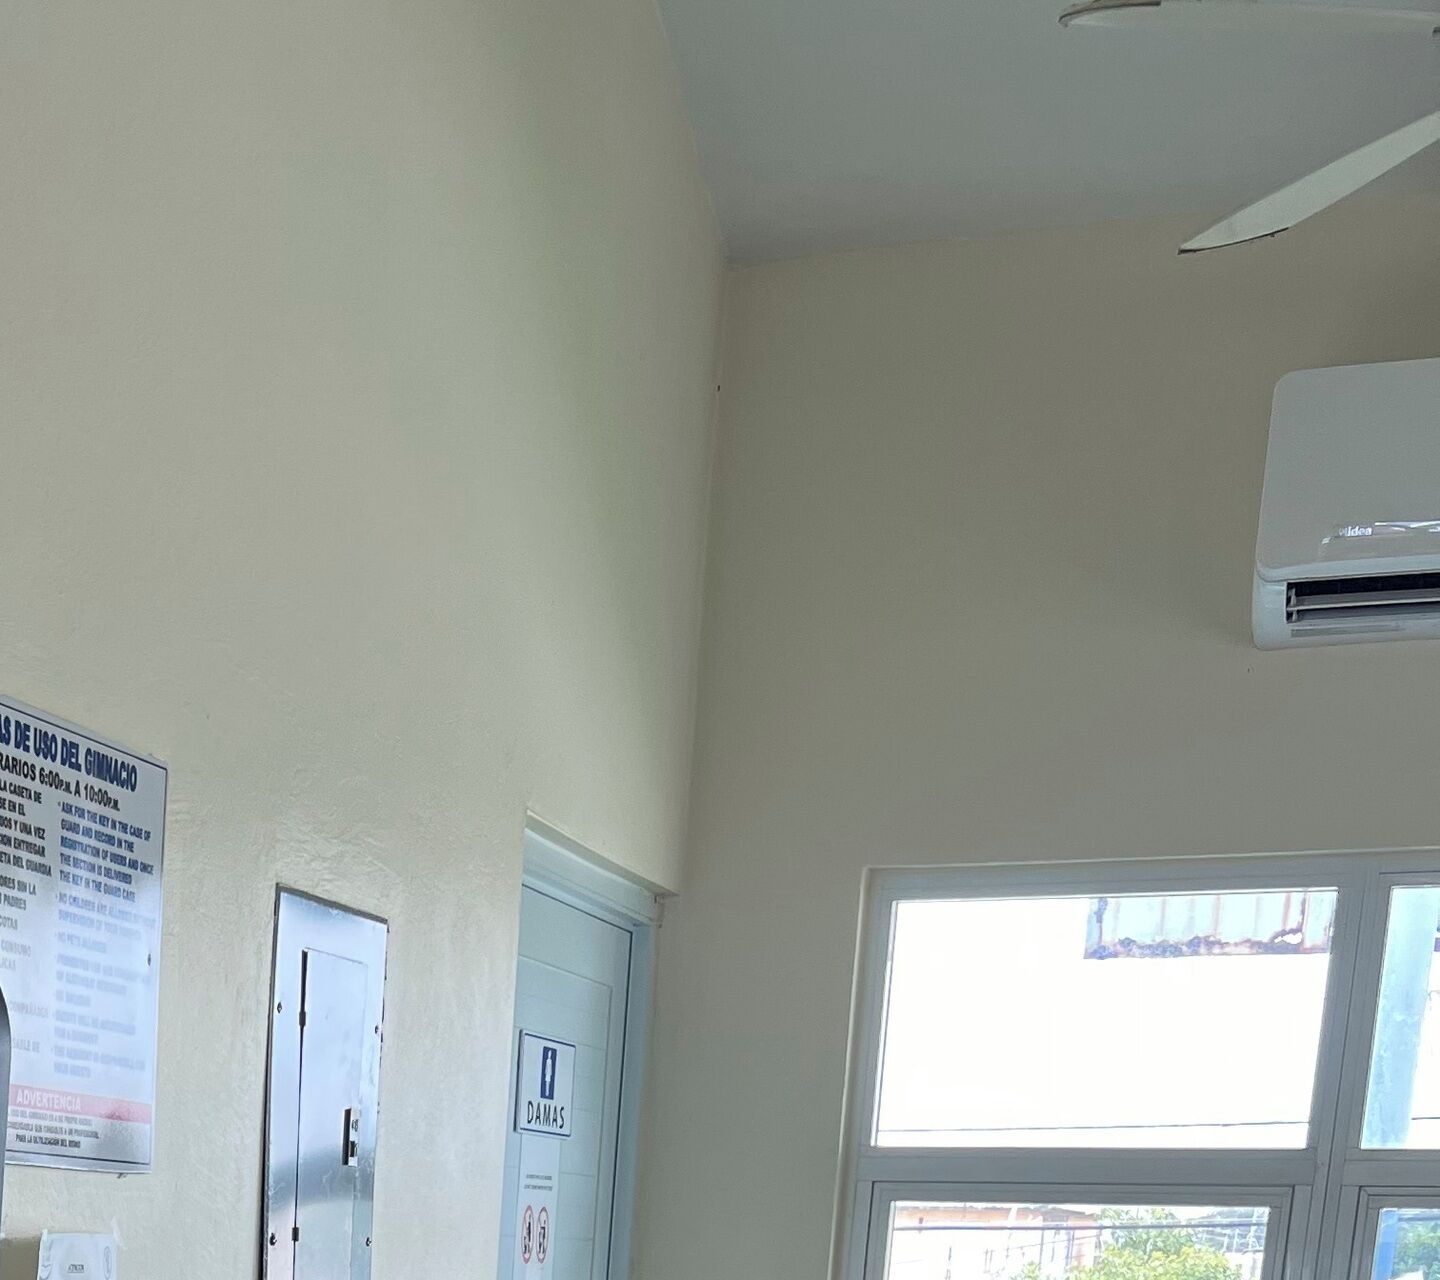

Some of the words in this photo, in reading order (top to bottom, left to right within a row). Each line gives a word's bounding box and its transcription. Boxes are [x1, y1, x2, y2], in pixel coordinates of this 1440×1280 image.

[15, 720, 30, 753] DE
[34, 727, 58, 763] USO
[61, 737, 82, 772] DEL
[85, 747, 137, 792] GIMNACIO
[0, 779, 7, 792] LA
[9, 782, 32, 801] CASETA
[34, 790, 42, 804] DE
[74, 780, 81, 798] A
[8, 799, 16, 813] EN
[18, 802, 26, 816] EL
[13, 819, 18, 831] Y
[19, 821, 32, 836] UNA
[33, 825, 46, 841] VEZ
[12, 854, 24, 869] DEL
[29, 882, 36, 896] LA
[17, 1089, 81, 1112] ADVERTENCIA
[527, 1100, 565, 1129] DAMAS
